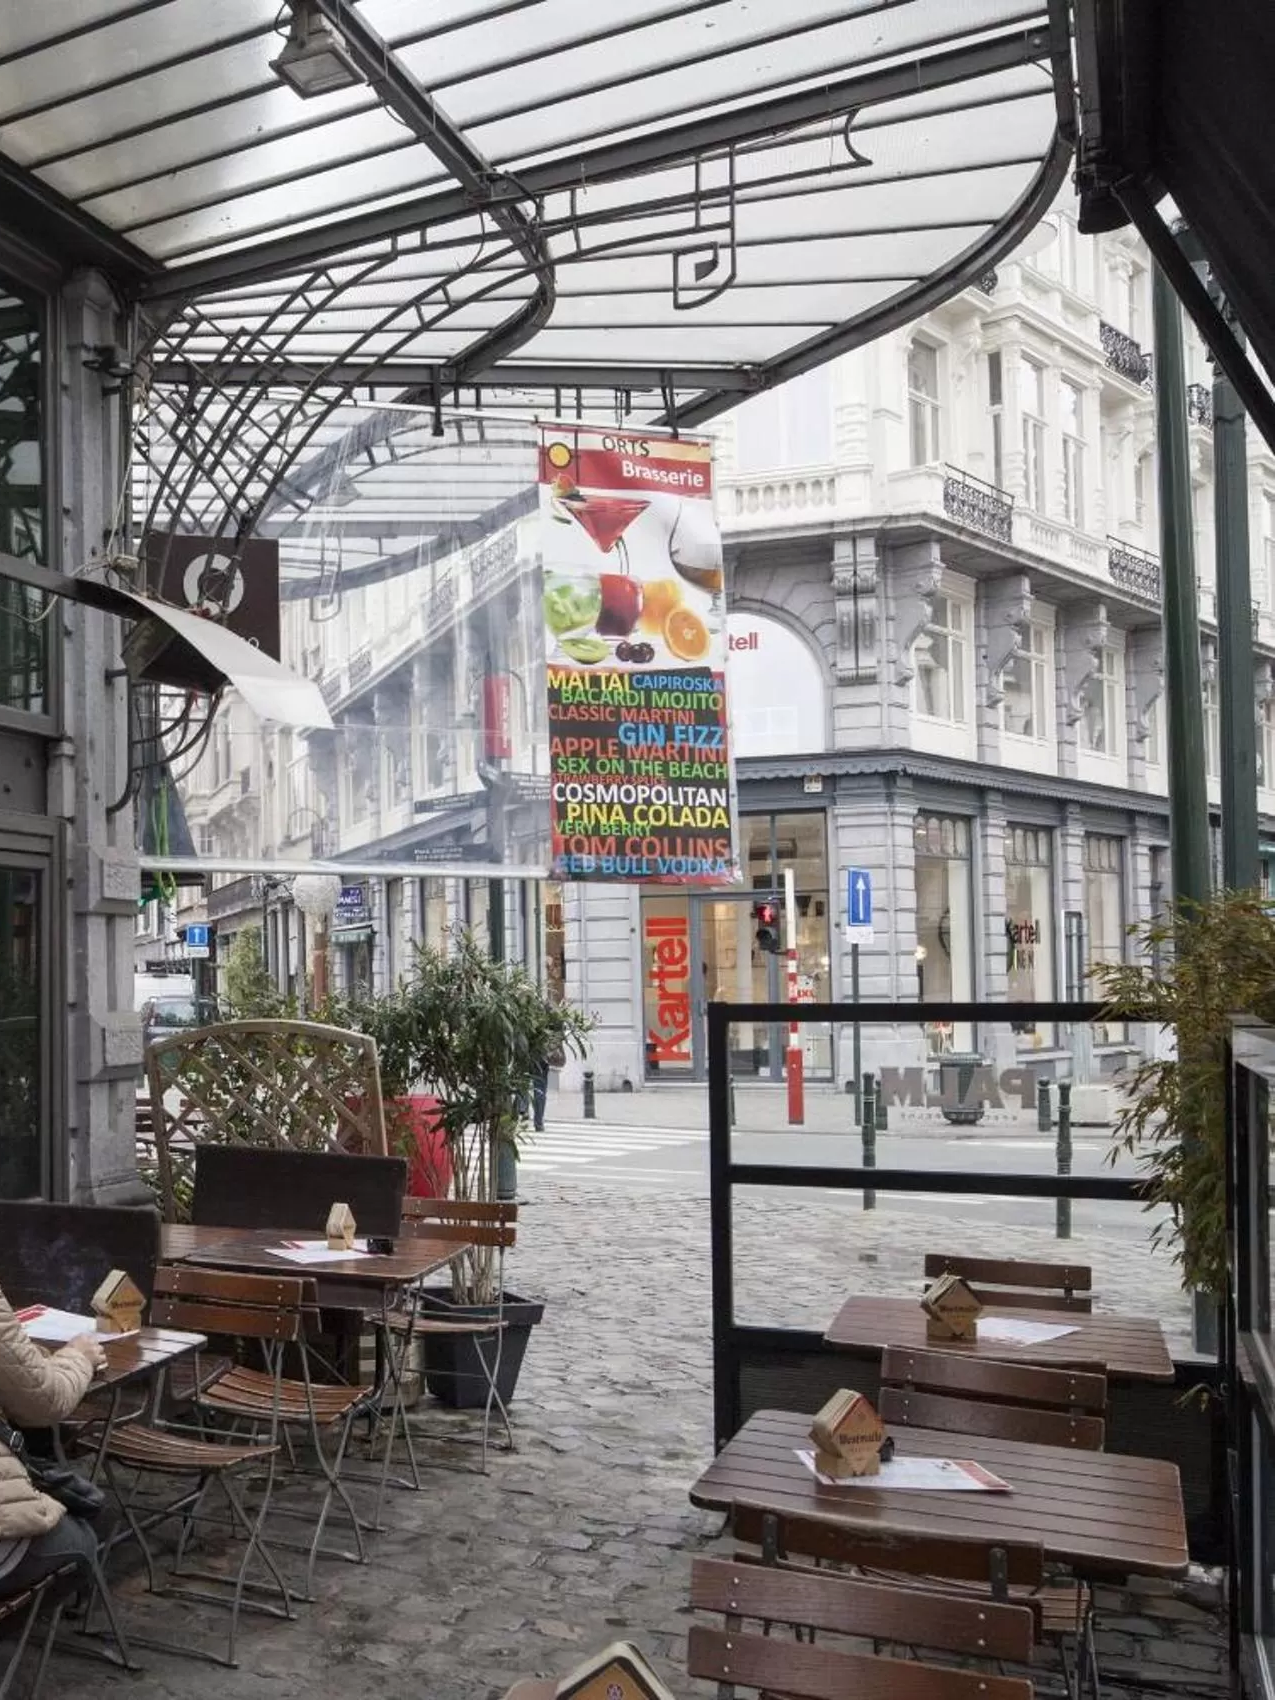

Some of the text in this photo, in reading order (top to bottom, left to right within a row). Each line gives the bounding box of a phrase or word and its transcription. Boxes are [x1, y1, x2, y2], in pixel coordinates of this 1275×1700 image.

[602, 435, 650, 457] ORTS
[621, 460, 705, 487] Brasserie
[728, 631, 758, 651] tell
[548, 670, 630, 691] MAI TAI
[632, 674, 724, 692] CAIPIROSKA
[561, 687, 722, 710] BACARDI MOJITO
[550, 704, 695, 725] CLASSIC MARTINI
[618, 722, 724, 748] GIN FIZZ
[550, 736, 727, 762] APPLE MARTINI
[552, 773, 627, 785] STRAWBERRY
[556, 757, 729, 780] SEX ON THE BEACH
[552, 782, 728, 808] COSMOPOLITAN
[566, 803, 730, 829] PINA COLADA
[553, 820, 653, 837] VERY BERRY
[556, 835, 730, 860] TOM COLLINS
[555, 853, 727, 876] RED BULL VODKA
[1005, 918, 1041, 945] Kartell
[646, 917, 691, 1061] Kartell
